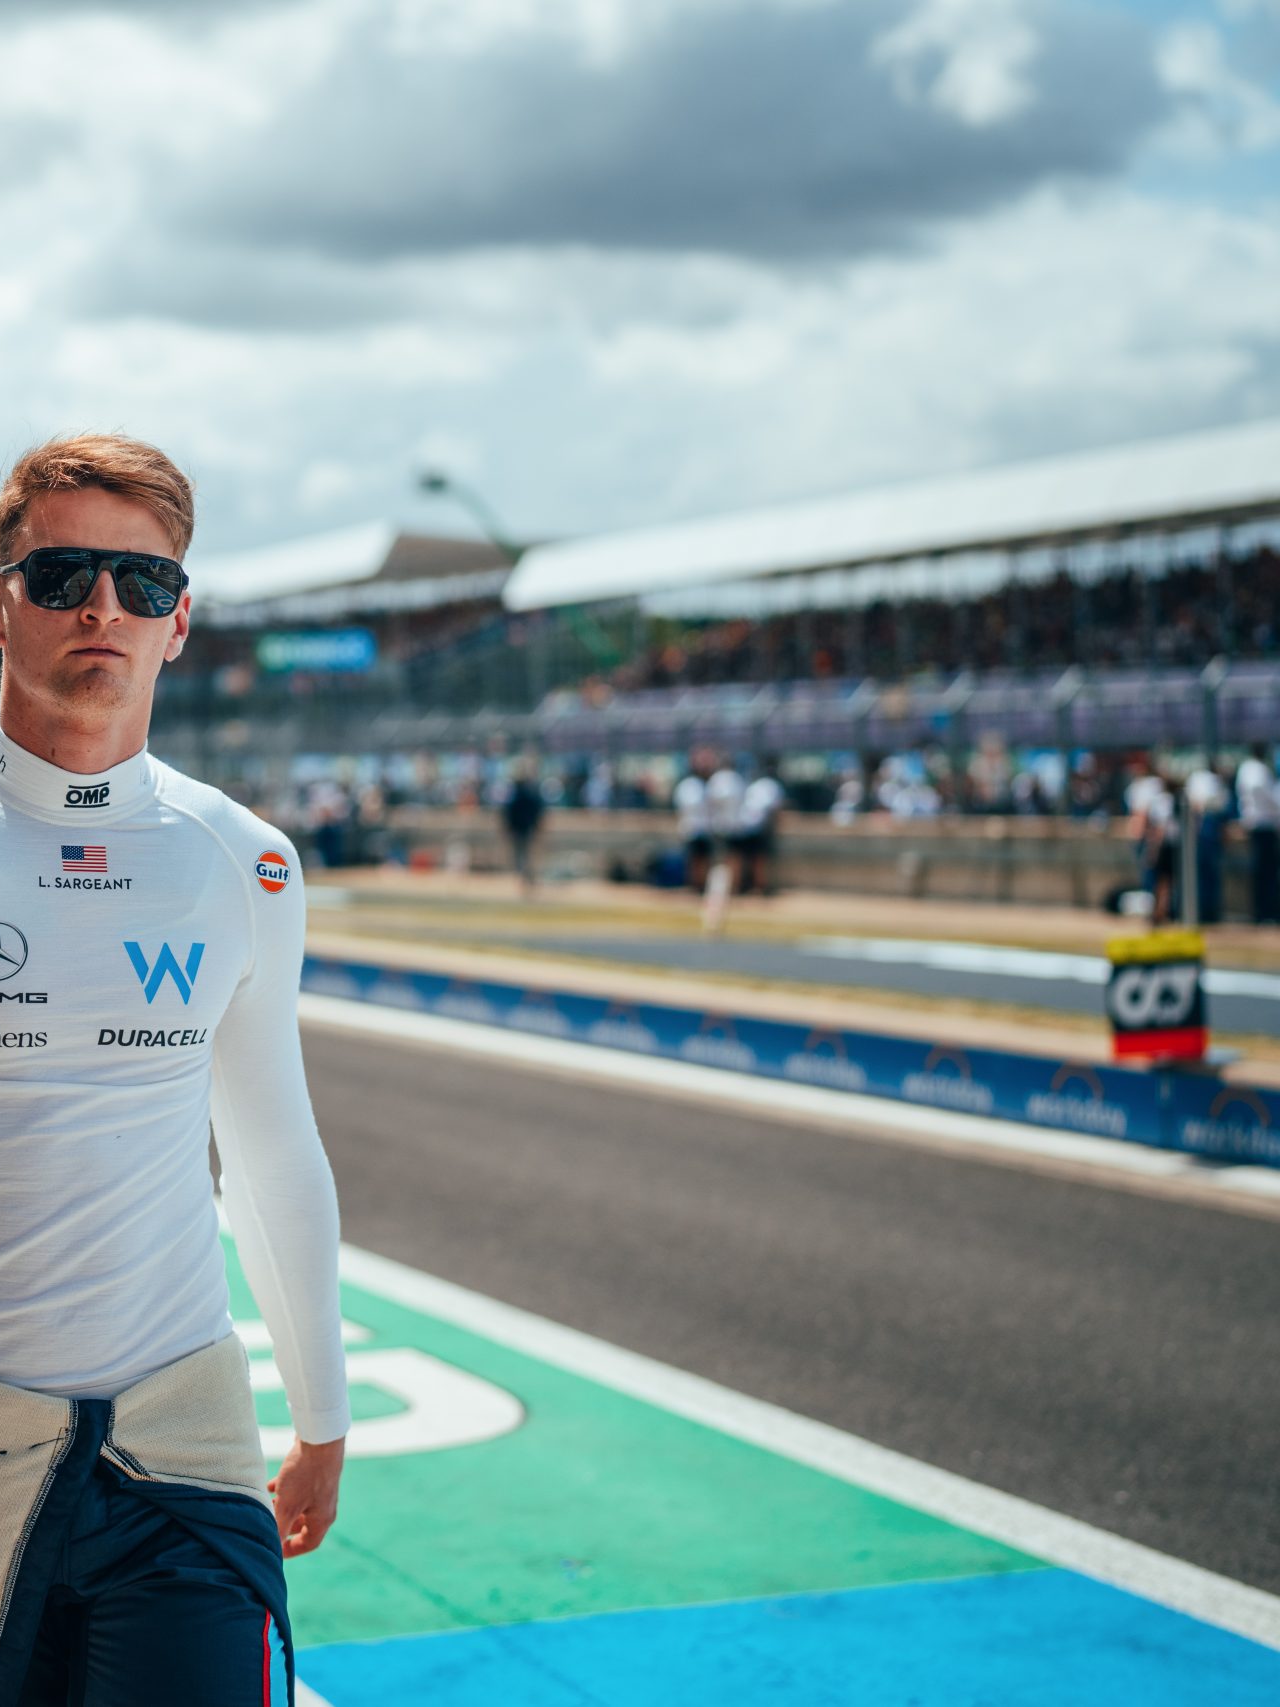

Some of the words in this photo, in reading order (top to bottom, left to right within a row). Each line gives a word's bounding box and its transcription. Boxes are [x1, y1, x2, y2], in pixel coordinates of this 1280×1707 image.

[66, 786, 110, 805] OMP
[256, 863, 289, 881] Gulf
[38, 875, 51, 888] L.
[54, 876, 133, 890] SARGEANT
[122, 941, 206, 1006] W
[97, 1028, 207, 1047] DURACELL
